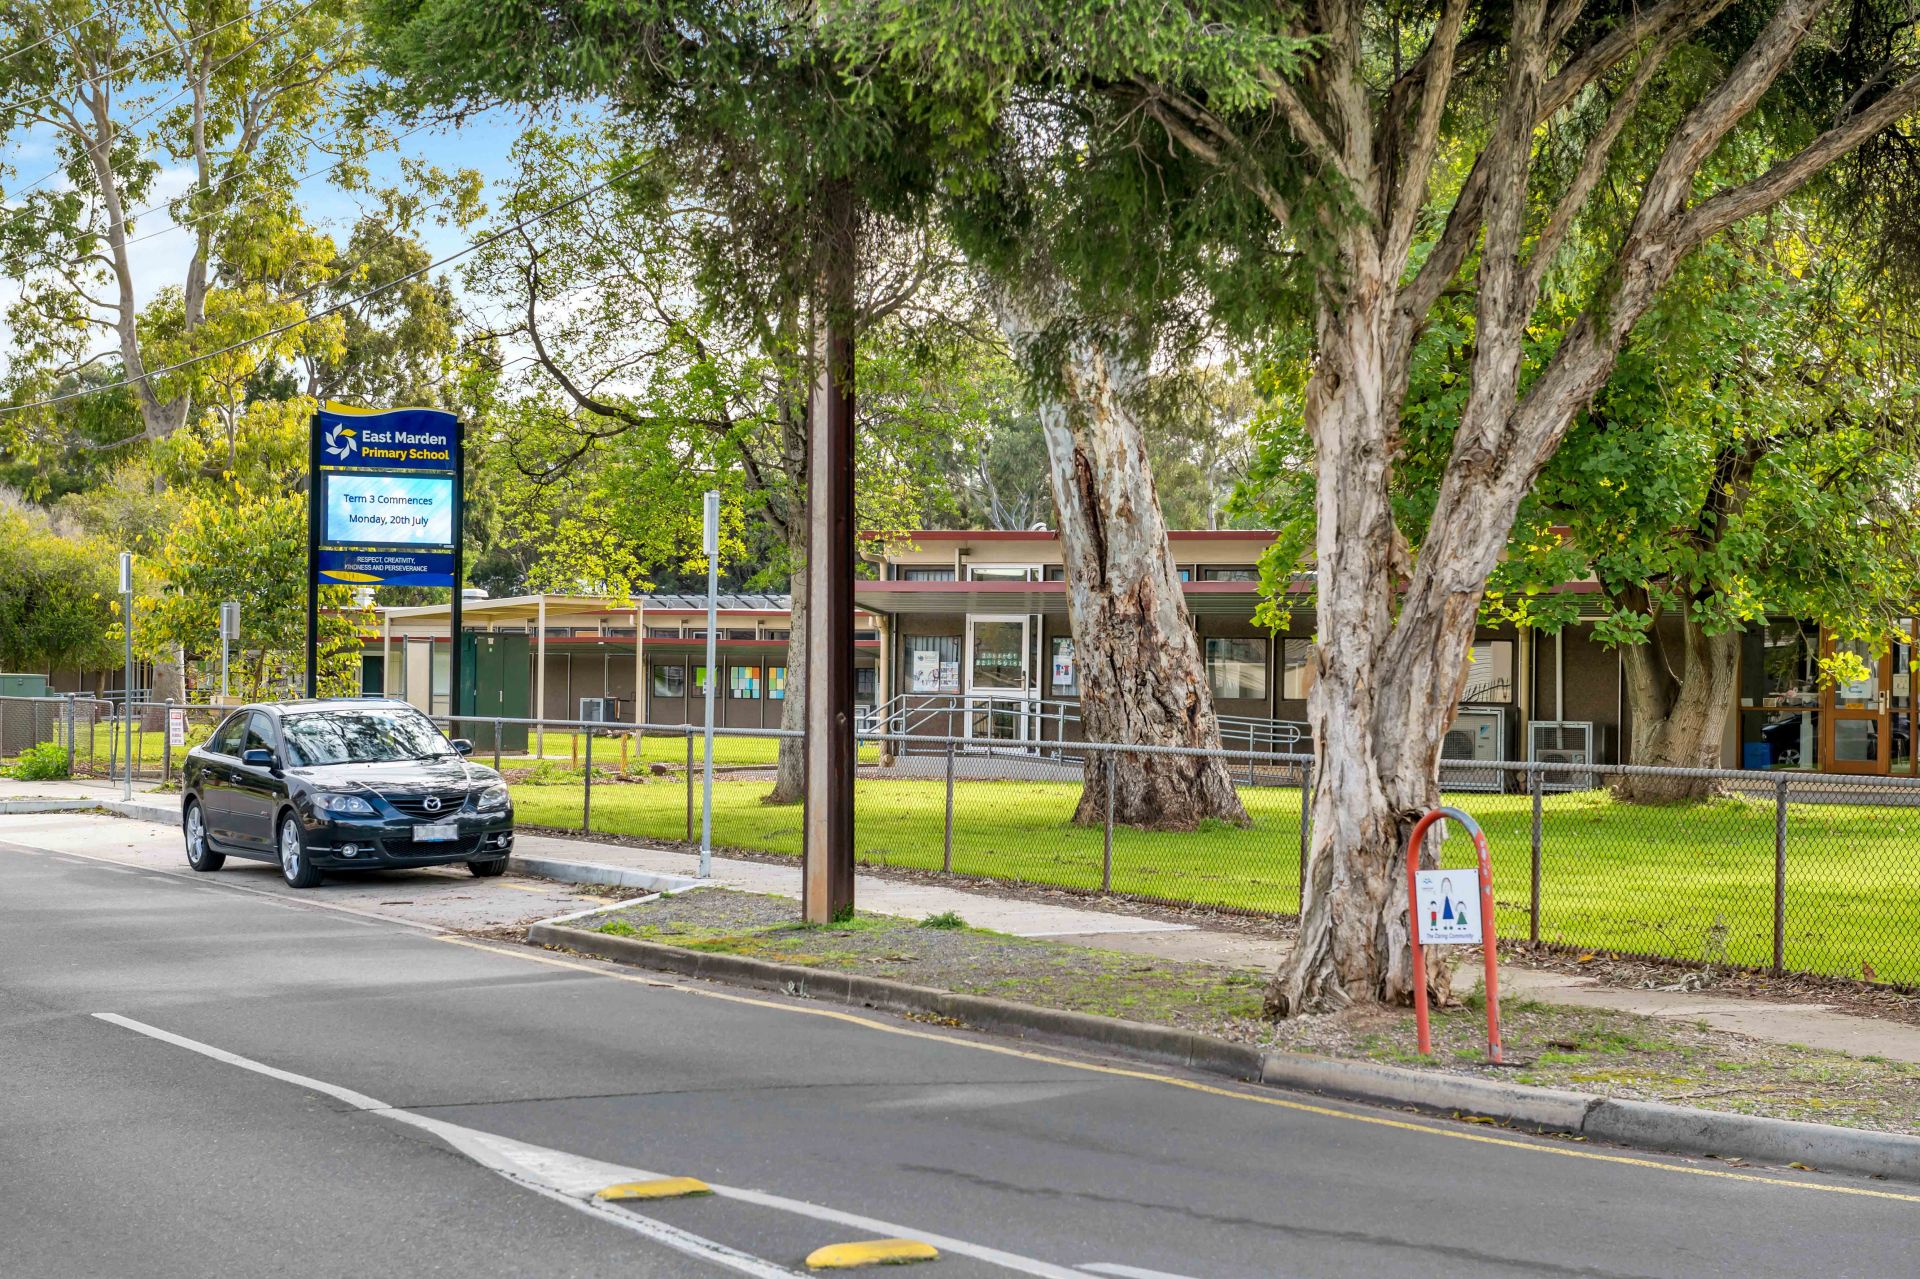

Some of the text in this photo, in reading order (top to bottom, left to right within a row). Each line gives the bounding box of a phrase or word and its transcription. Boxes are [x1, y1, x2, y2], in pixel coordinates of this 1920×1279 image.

[362, 430, 447, 445] East Marden
[362, 447, 449, 461] Primary School
[344, 494, 433, 505] Term 3 Commences
[349, 514, 429, 527] Monday, 20th July
[384, 557, 416, 565] CREATIVITY,
